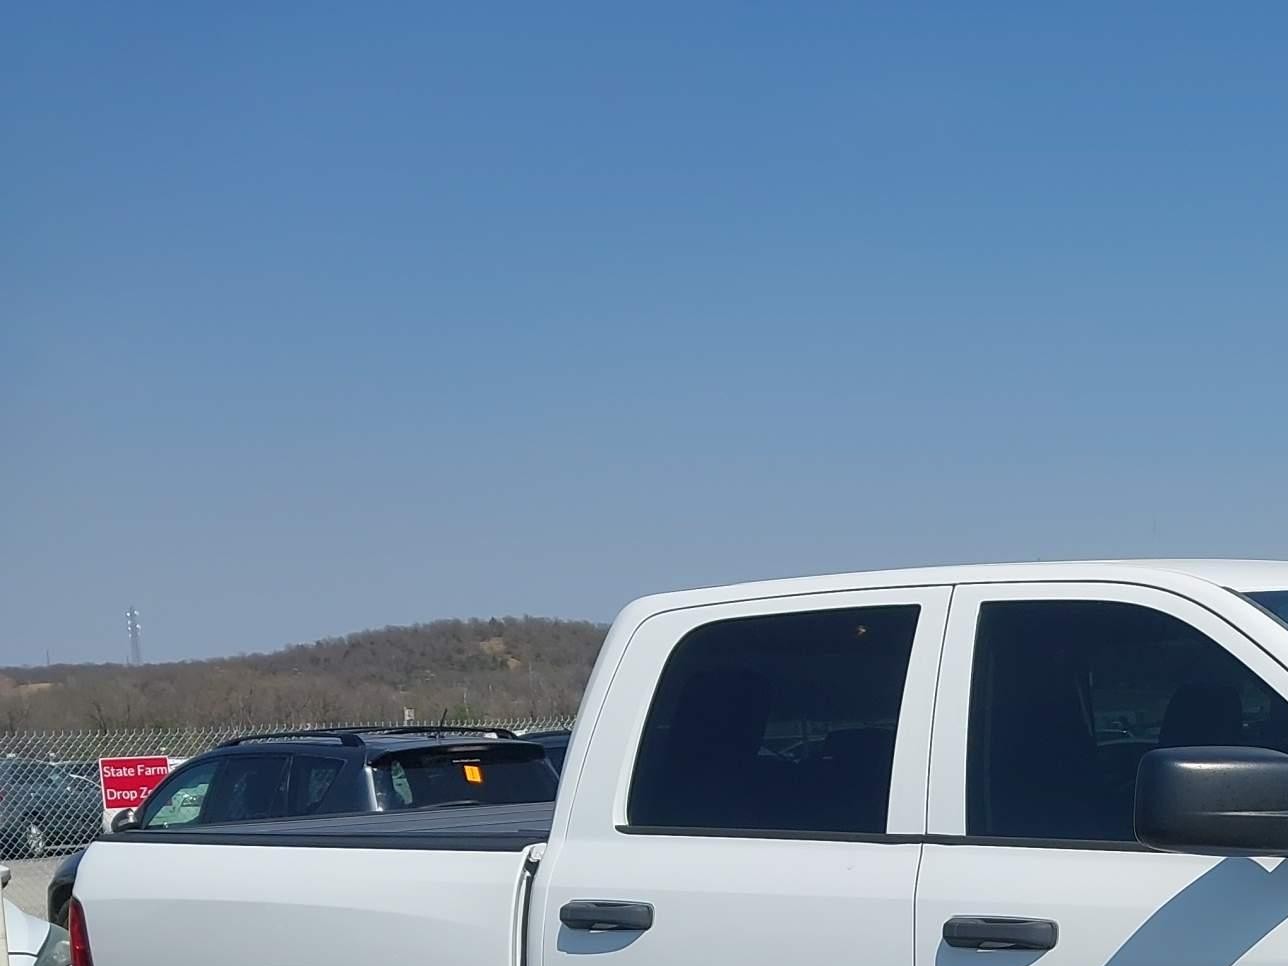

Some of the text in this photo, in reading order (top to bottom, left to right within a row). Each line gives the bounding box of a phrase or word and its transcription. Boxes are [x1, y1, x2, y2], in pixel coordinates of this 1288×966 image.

[103, 764, 168, 778] State Farm
[106, 788, 138, 801] Drop
